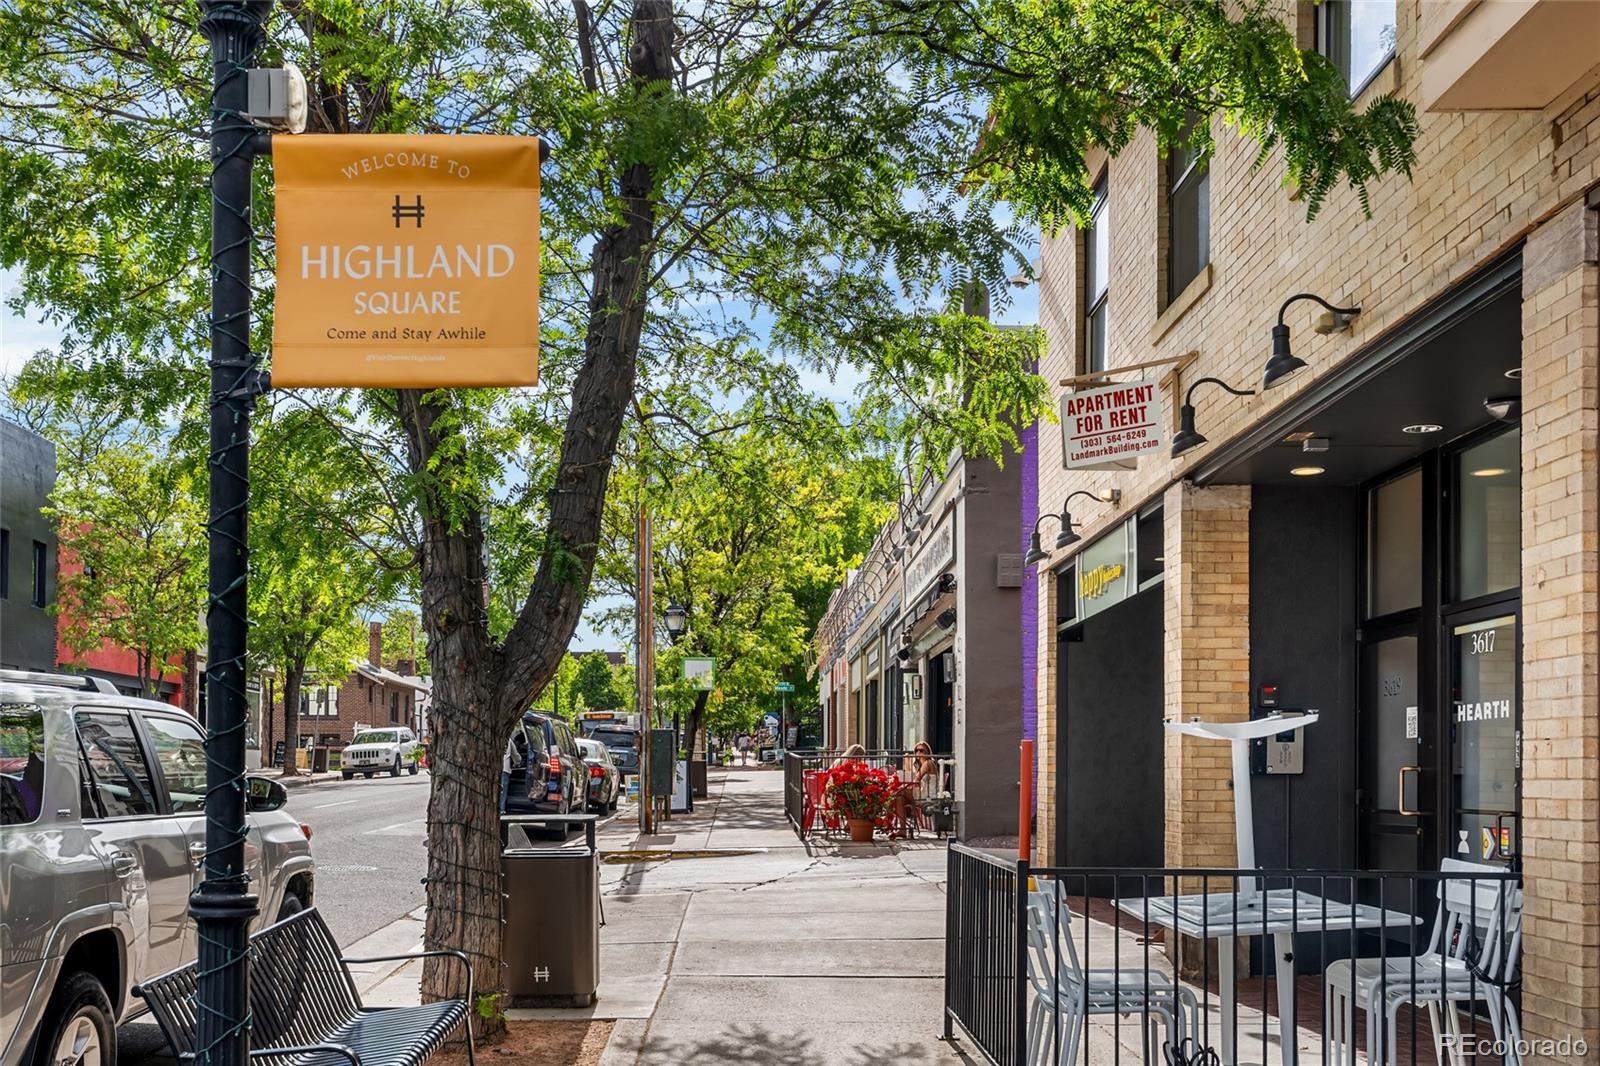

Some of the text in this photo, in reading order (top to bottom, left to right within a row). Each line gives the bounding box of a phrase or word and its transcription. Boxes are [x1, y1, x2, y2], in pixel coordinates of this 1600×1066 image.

[341, 152, 471, 180] WELCOME TO
[301, 244, 515, 280] HIGHLAND
[354, 291, 461, 315] SQUARE
[326, 327, 487, 342] Come and Stay Awhile
[1067, 384, 1154, 416] APARTMENT
[1076, 405, 1148, 434] FOR RENT
[1070, 439, 1159, 461] LandmarkBuilding.com
[1080, 436, 1103, 449] (303)
[1470, 630, 1496, 655] 3617
[1457, 700, 1510, 722] HEARTH
